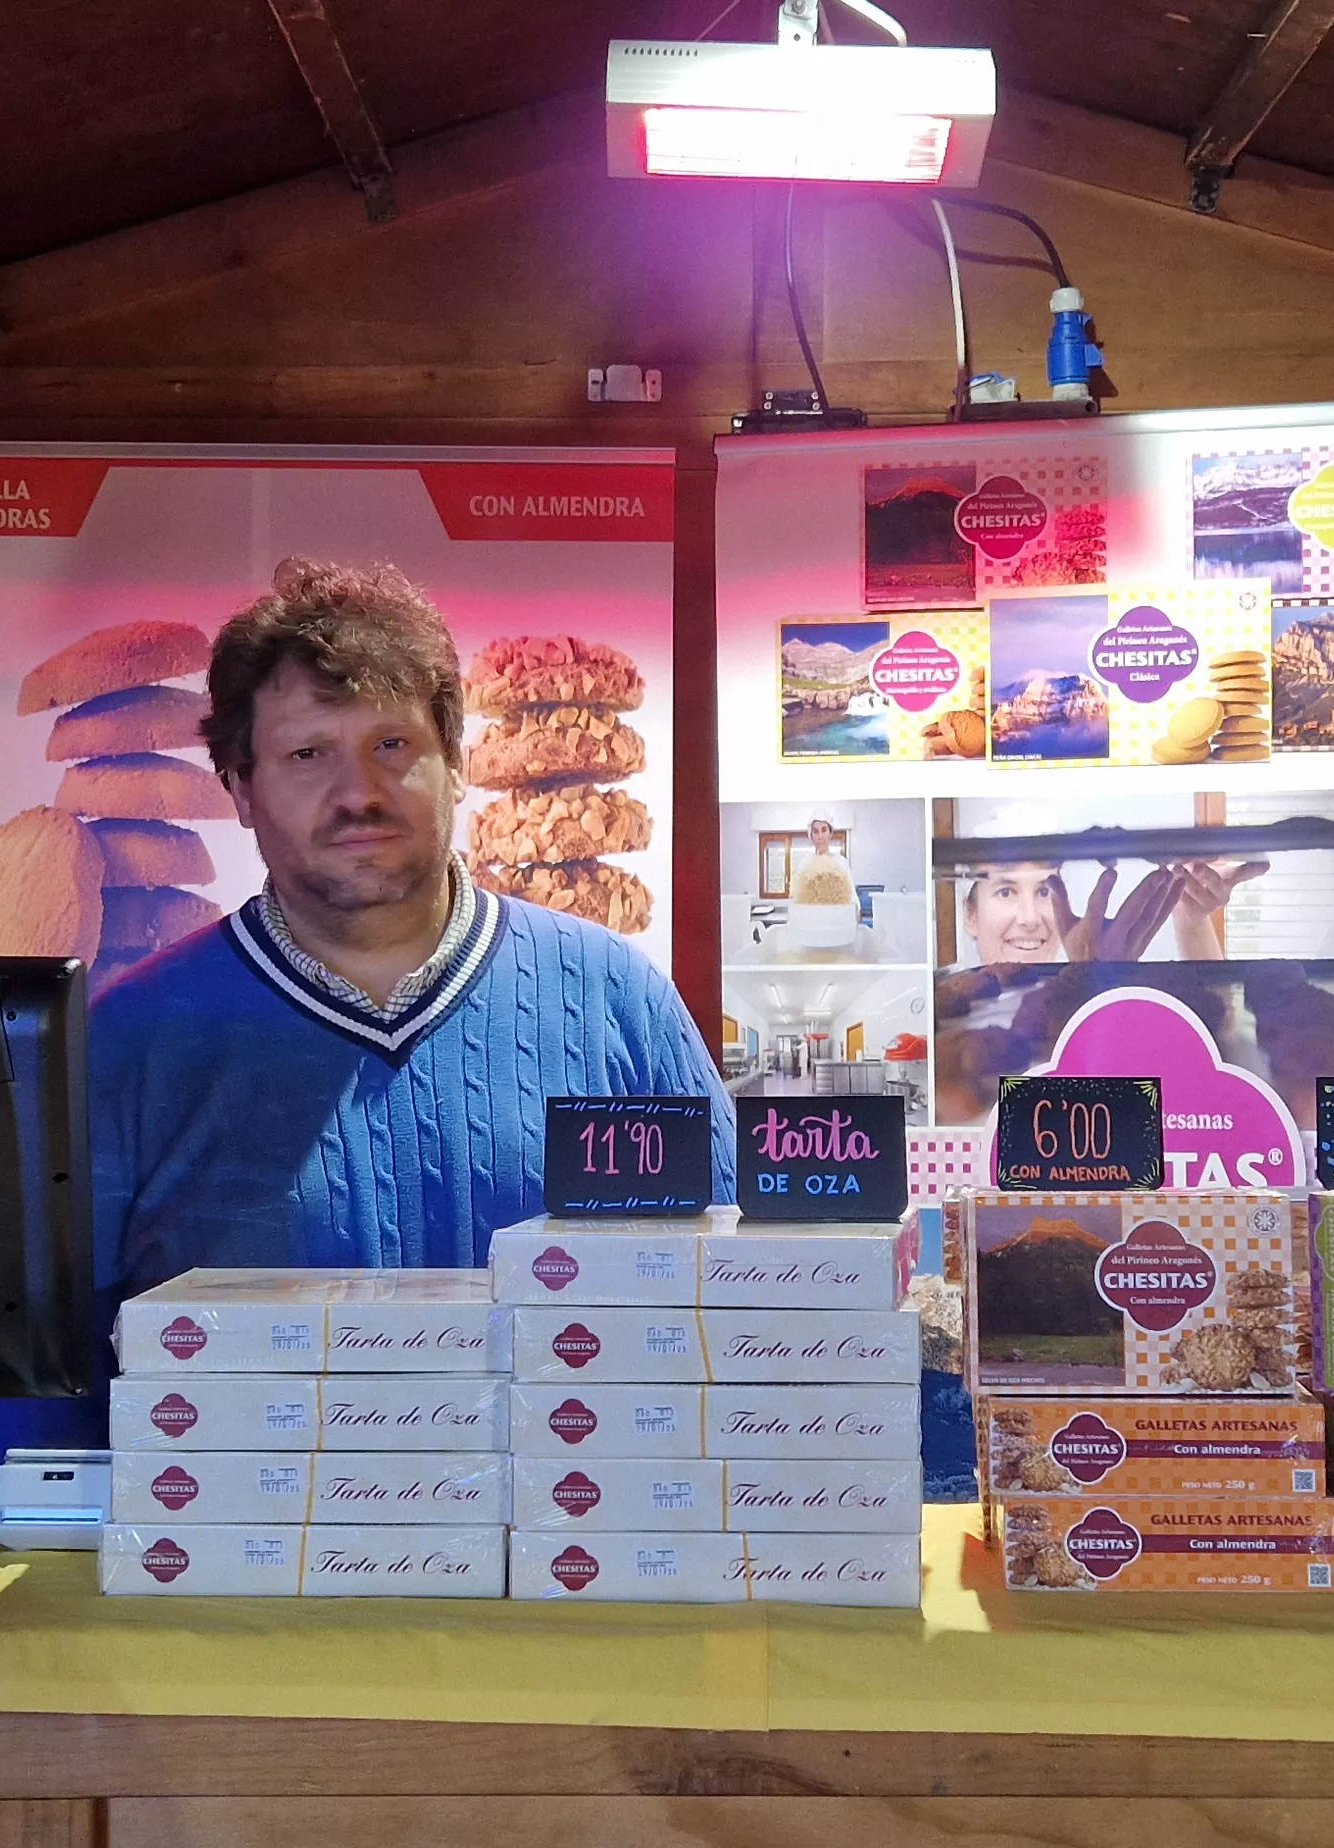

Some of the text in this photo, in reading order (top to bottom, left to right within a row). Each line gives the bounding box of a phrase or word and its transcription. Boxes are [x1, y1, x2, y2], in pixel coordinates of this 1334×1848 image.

[469, 495, 645, 518] CON ALMENDRA
[752, 1108, 880, 1162] tarta
[1033, 1099, 1112, 1160] 6'00
[579, 1119, 663, 1175] 11'90
[756, 1173, 861, 1196] DE OZA
[1009, 1164, 1132, 1182] CON ALMENDRA
[700, 1259, 860, 1285] Tarta de Oza
[1111, 1256, 1203, 1267] del Pirineo Aragonés
[1130, 1296, 1186, 1305] Con almendra
[328, 1326, 395, 1349] Tarta
[402, 1327, 428, 1349] de
[436, 1326, 485, 1349] Oza
[723, 1334, 887, 1359] Tarta de Oza
[320, 1402, 388, 1426] Tarta
[397, 1404, 423, 1426] de
[430, 1403, 480, 1426] Oza
[721, 1411, 885, 1436] Tarta de Oza
[1135, 1419, 1298, 1432] GALLETAS ARTESANAS
[1174, 1443, 1261, 1455] Con almendra
[320, 1477, 482, 1500] Tarta de Oza
[728, 1483, 888, 1508] Tarta de Oza
[1150, 1514, 1313, 1526] GALLETAS ARTESANAS
[1189, 1539, 1276, 1550] Con almendra
[310, 1550, 471, 1574] Tarta de Oza
[722, 1558, 888, 1582] Tarta de Oza
